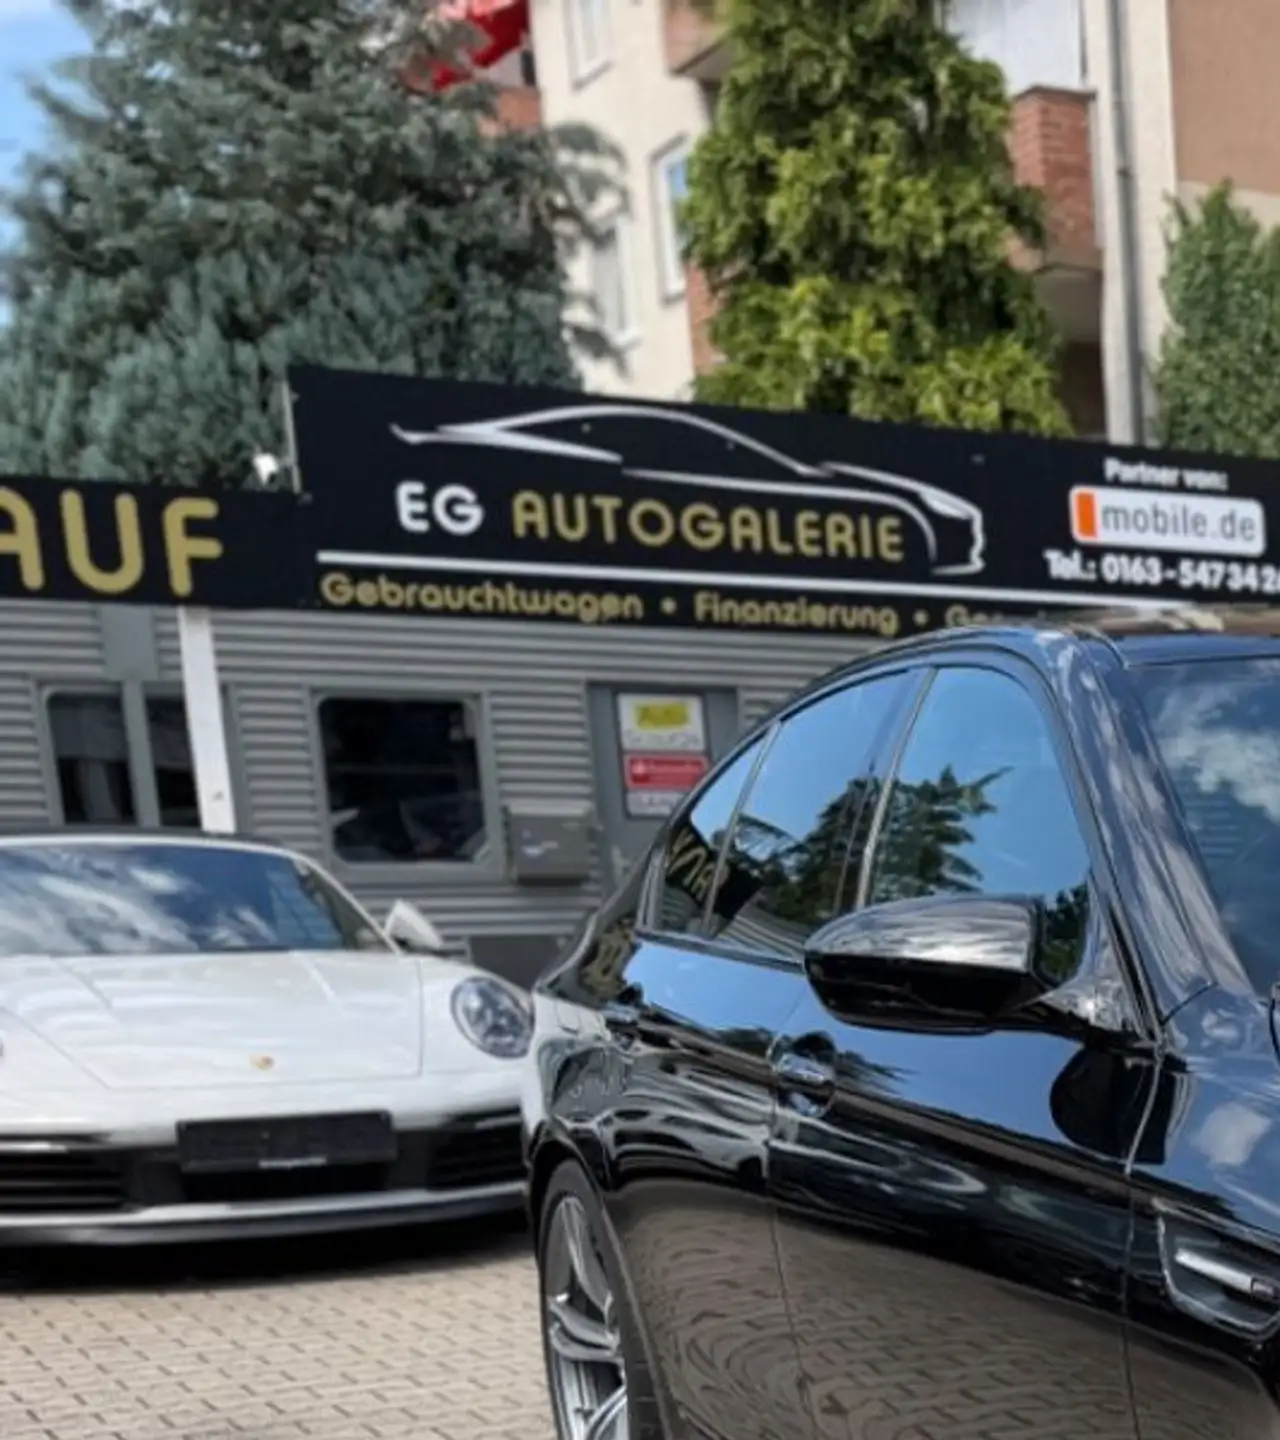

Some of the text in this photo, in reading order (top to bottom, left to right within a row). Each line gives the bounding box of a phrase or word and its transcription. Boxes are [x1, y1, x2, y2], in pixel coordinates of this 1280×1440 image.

[1102, 456, 1180, 486] Partner
[395, 480, 905, 562] EG AUTOGALERIE
[1100, 501, 1257, 543] mobile.de
[320, 571, 645, 623] Gebrauchtwagen
[692, 589, 900, 637] Finanzierung
